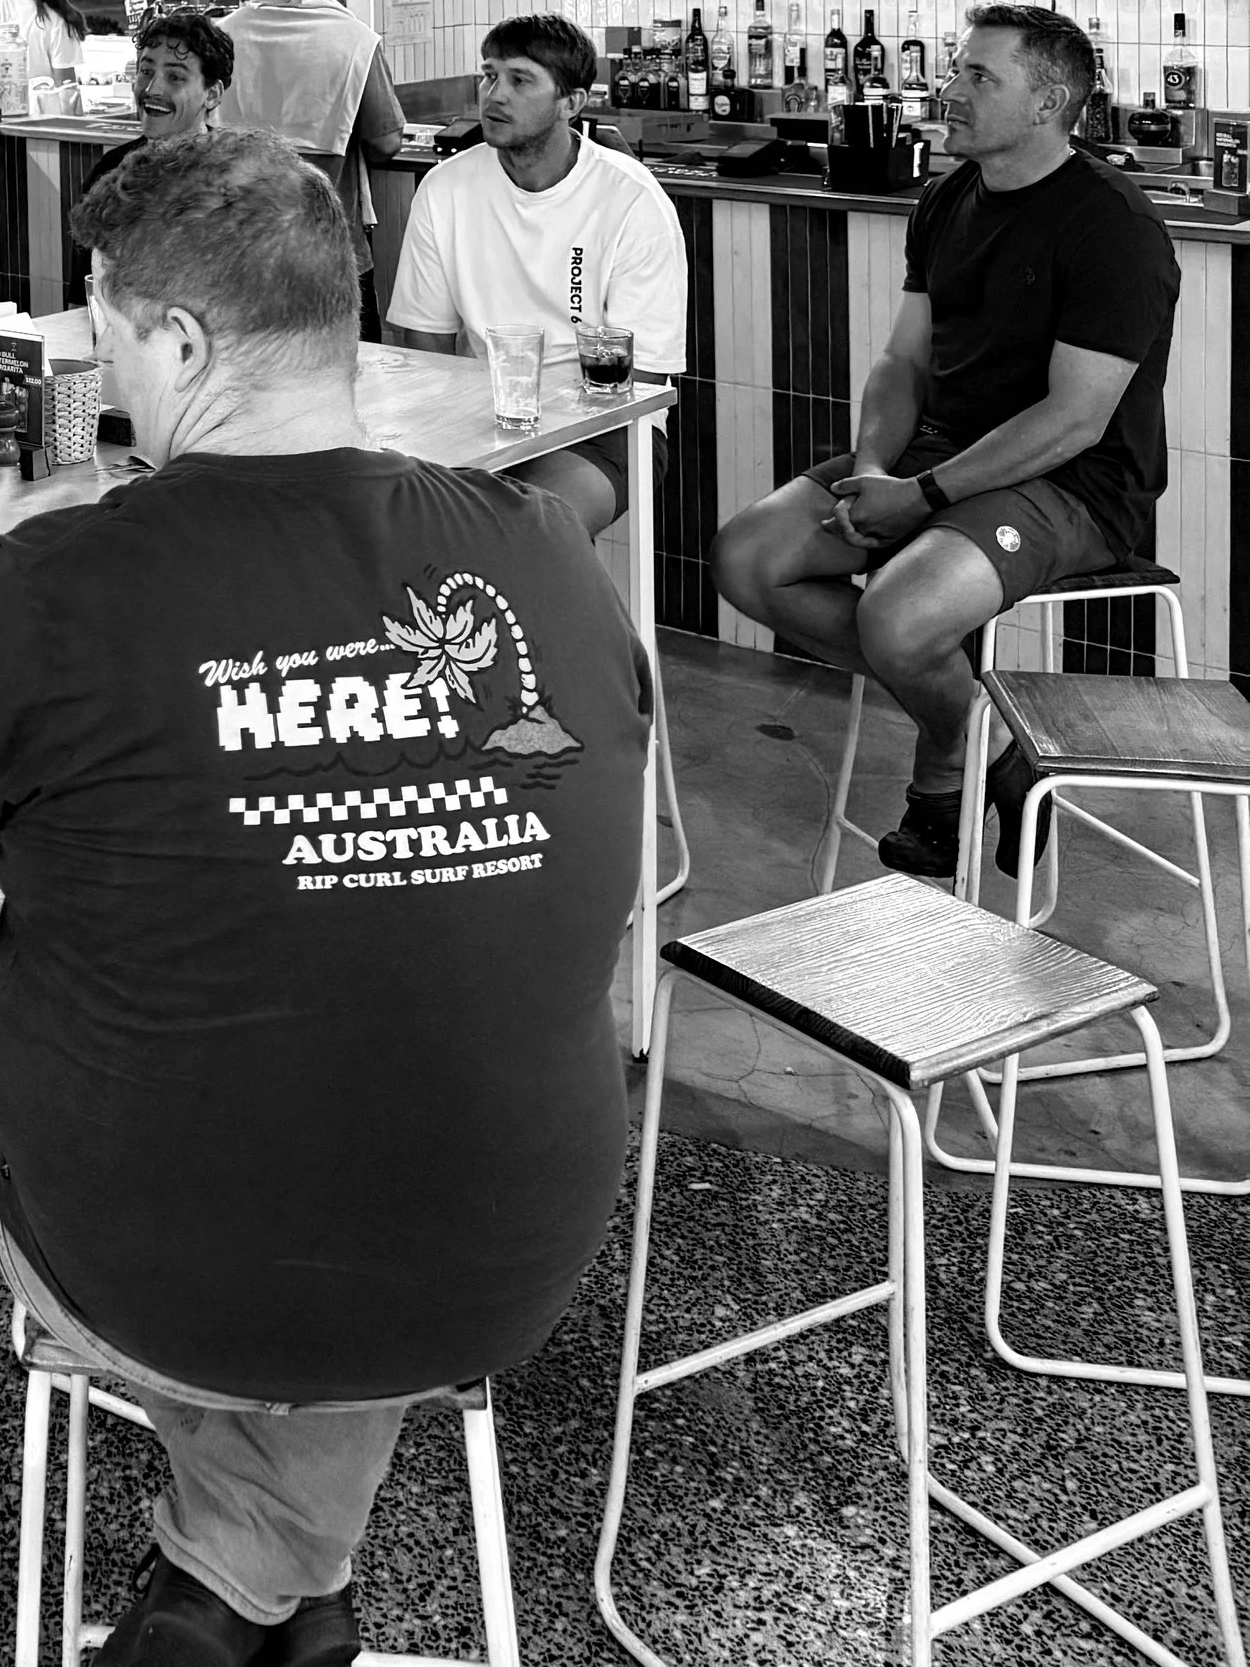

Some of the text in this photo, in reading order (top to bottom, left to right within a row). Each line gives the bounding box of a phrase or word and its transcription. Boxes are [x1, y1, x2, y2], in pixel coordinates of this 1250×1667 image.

[1167, 75, 1180, 84] 43
[570, 247, 584, 324] PROJECT 6
[1, 351, 16, 360] BULL
[198, 637, 396, 687] Wish you were...
[216, 672, 460, 751] HERE!
[282, 811, 551, 865] AUSTRALIA
[297, 853, 543, 890] RIP CURL SURF RESORT
